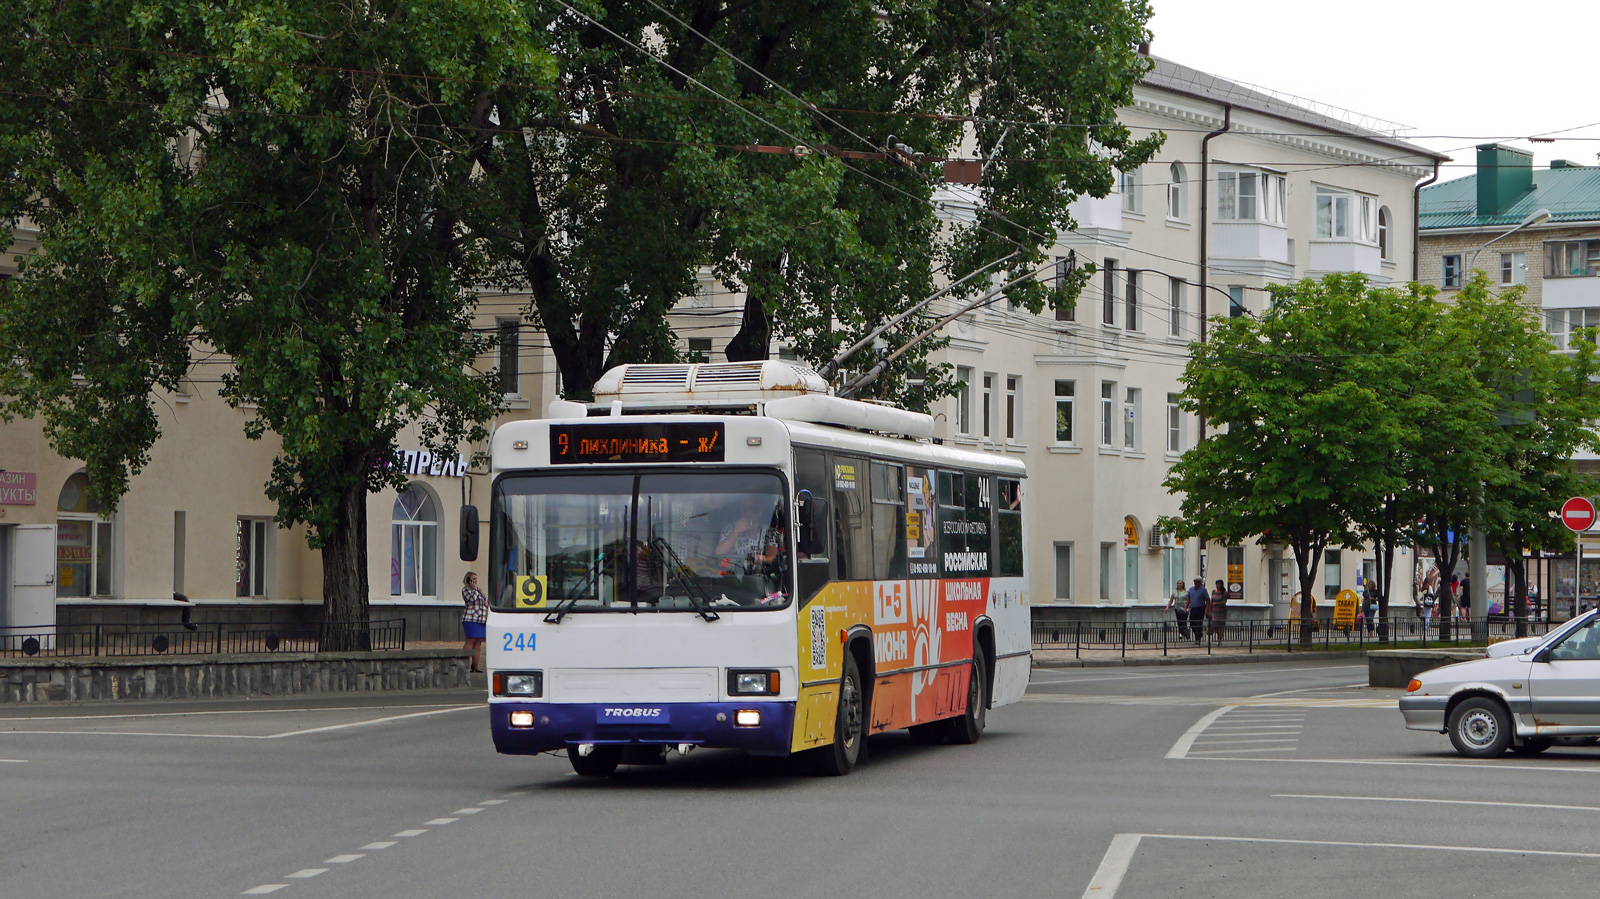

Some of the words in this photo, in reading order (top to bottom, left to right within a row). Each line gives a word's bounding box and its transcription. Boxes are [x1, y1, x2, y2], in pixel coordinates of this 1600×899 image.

[558, 433, 569, 455] 9
[978, 476, 990, 508] 244
[944, 547, 988, 572] РОССИЙСКАЯ
[521, 577, 543, 606] 9
[878, 582, 902, 619] 1-5
[945, 581, 982, 601] ШКОЛЬНАЯ
[946, 611, 969, 632] ВЕСНА
[503, 632, 537, 652] 244
[874, 629, 908, 664] ИЮНЯ
[603, 707, 662, 718] TROBUS
